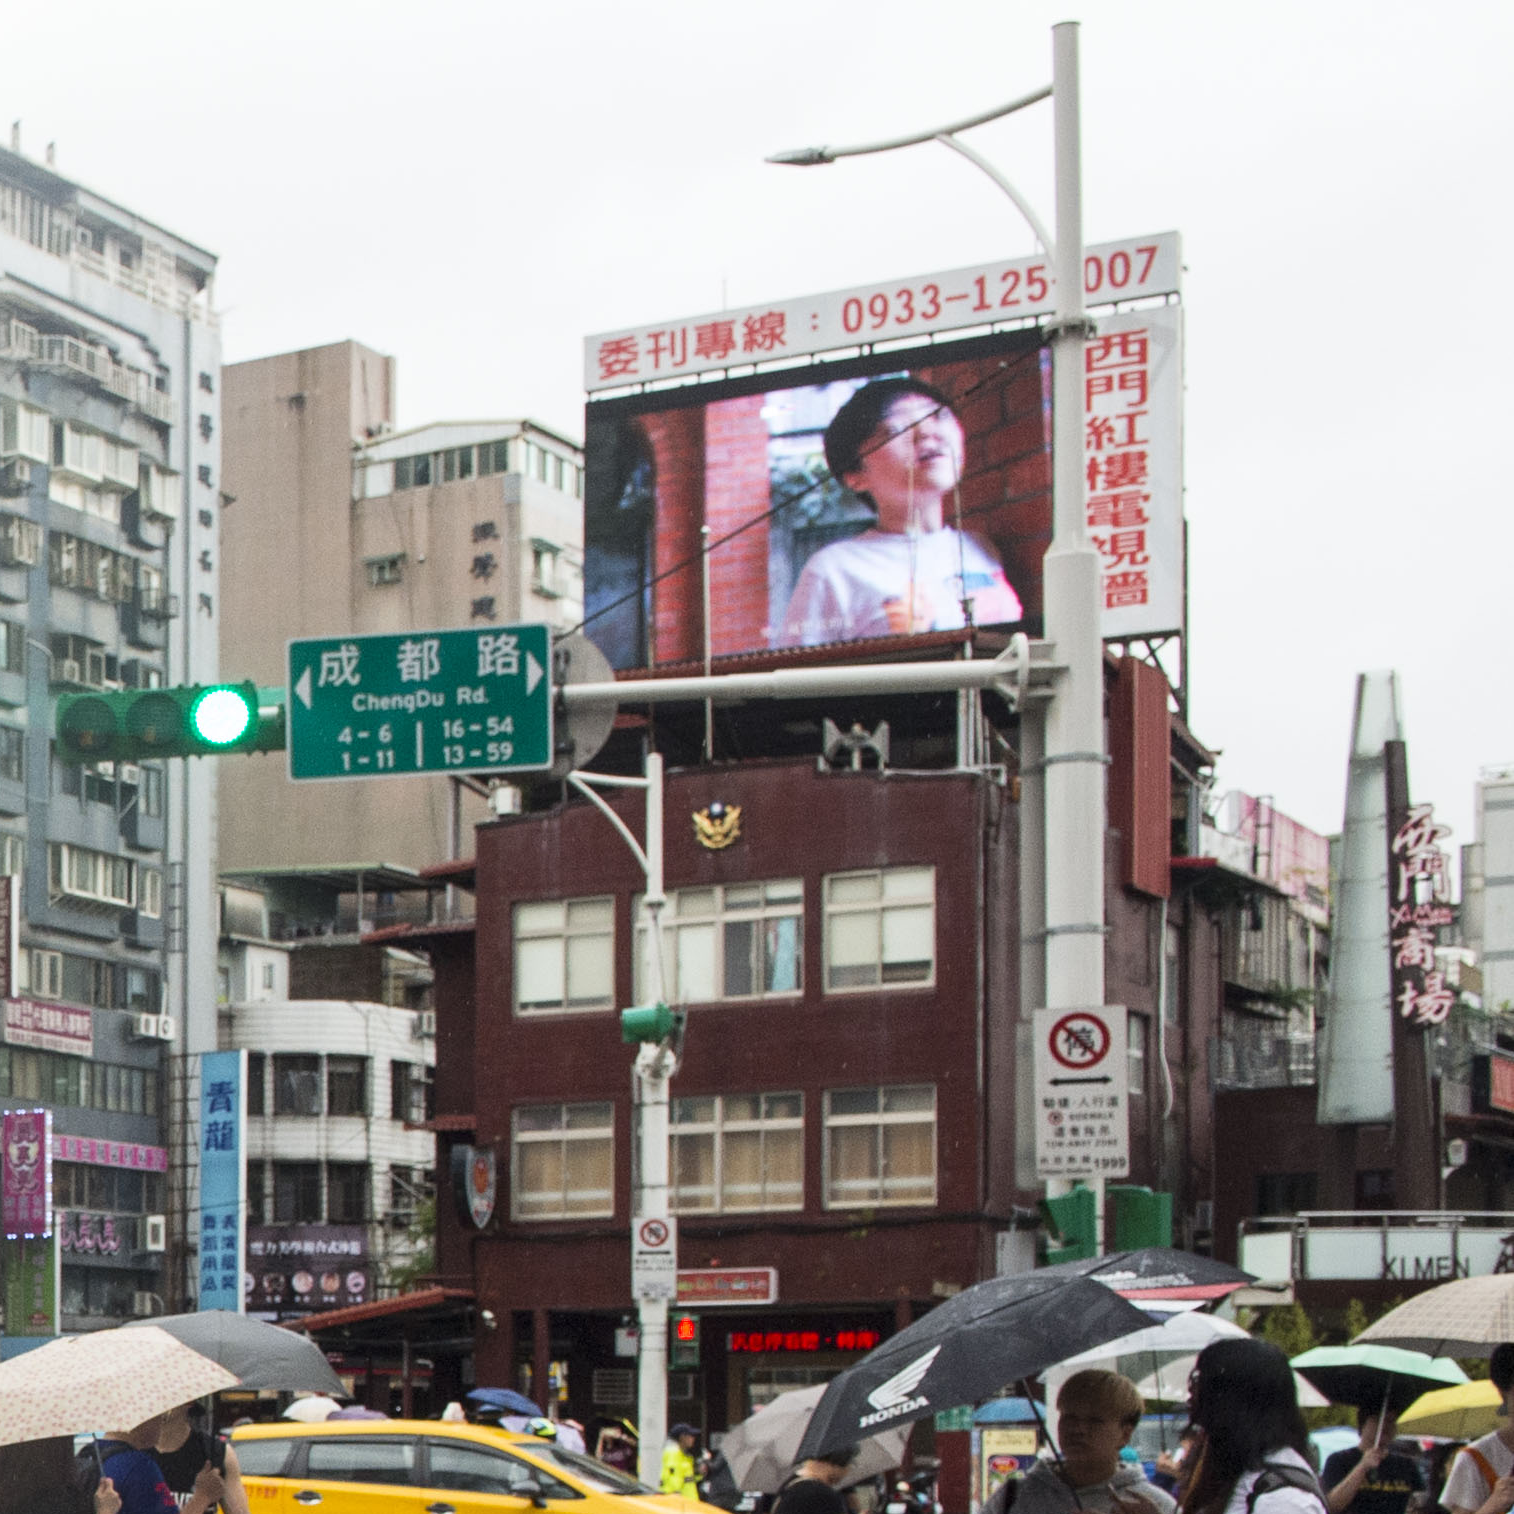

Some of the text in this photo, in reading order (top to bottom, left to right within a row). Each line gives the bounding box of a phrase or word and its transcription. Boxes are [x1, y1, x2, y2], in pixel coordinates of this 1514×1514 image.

[843, 246, 1159, 333] 0933-125007
[318, 635, 521, 688] 成都路
[352, 688, 489, 714] ChengDu Rd.
[205, 1080, 235, 1151] 青龍
[858, 1397, 929, 1428] HONDA
